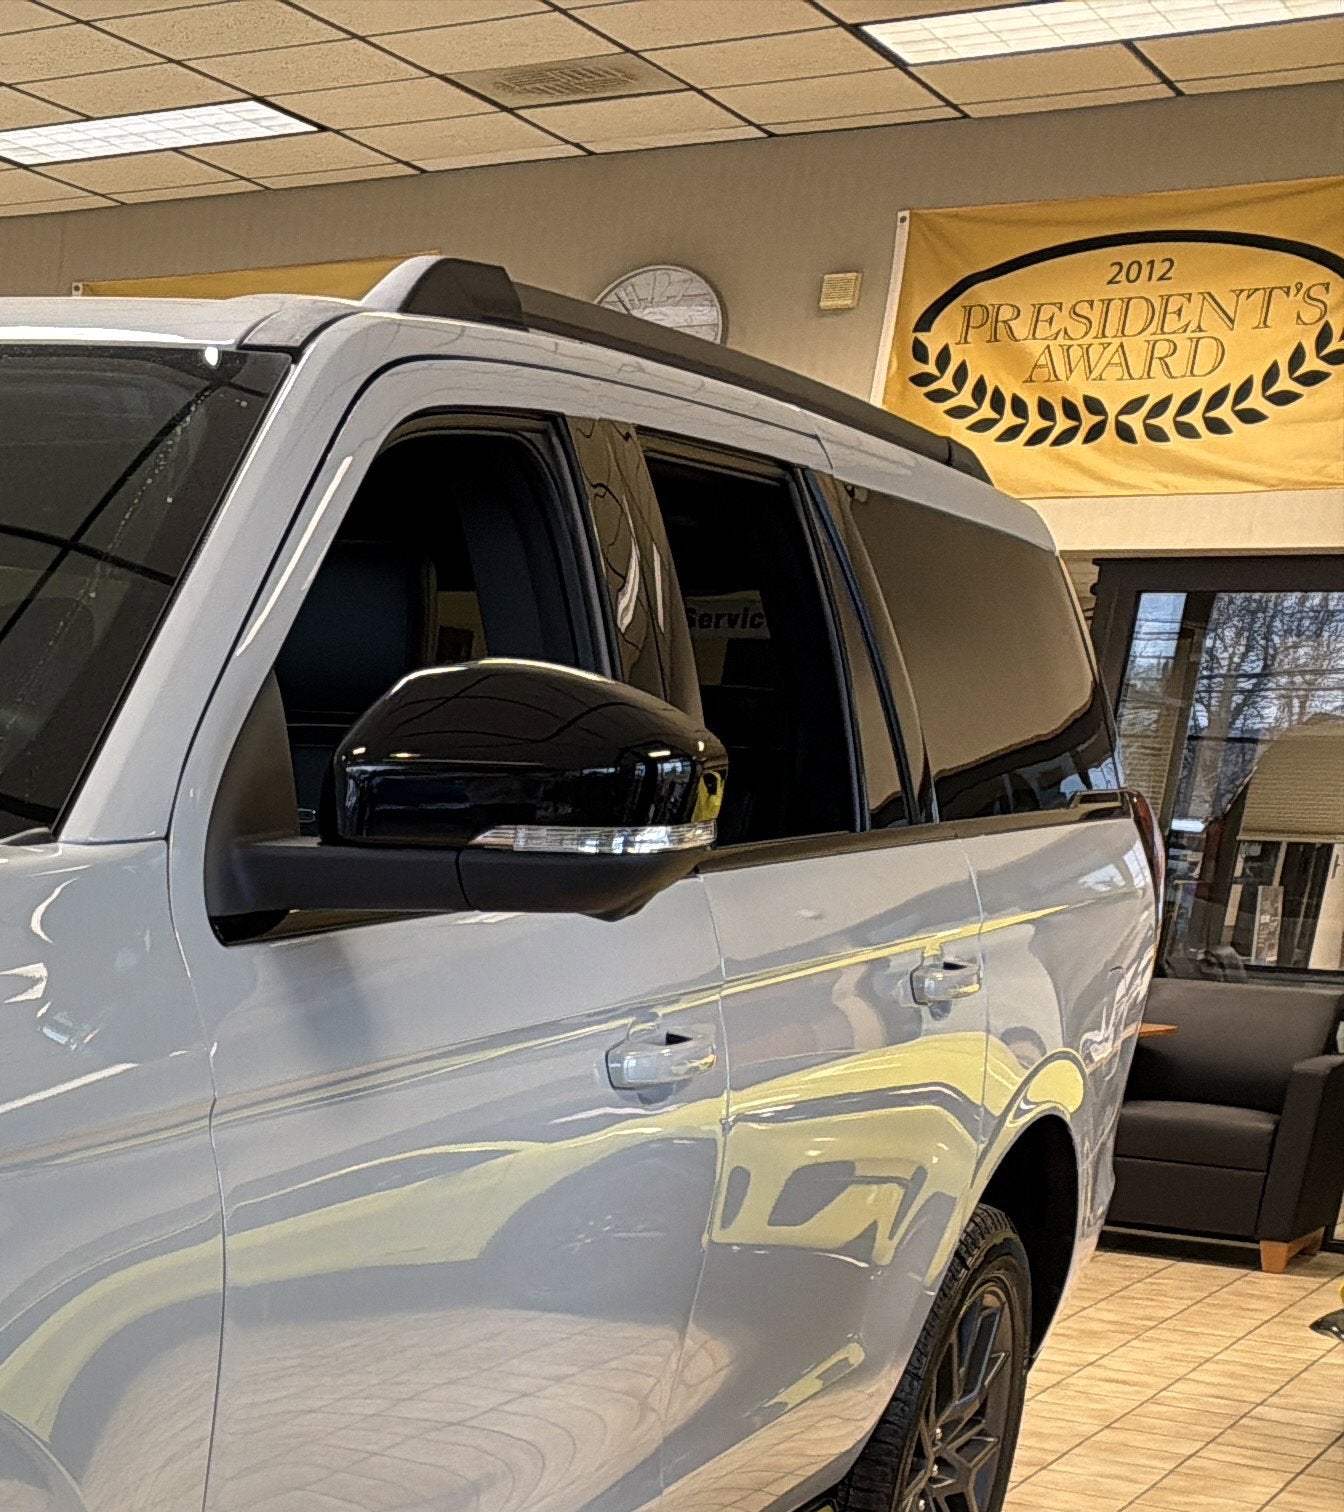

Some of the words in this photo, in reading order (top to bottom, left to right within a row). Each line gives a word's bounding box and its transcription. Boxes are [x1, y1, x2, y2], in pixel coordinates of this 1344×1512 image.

[1106, 257, 1175, 286] 2012
[955, 280, 1331, 346] PRESIDENT'S
[1022, 335, 1227, 384] AWARD
